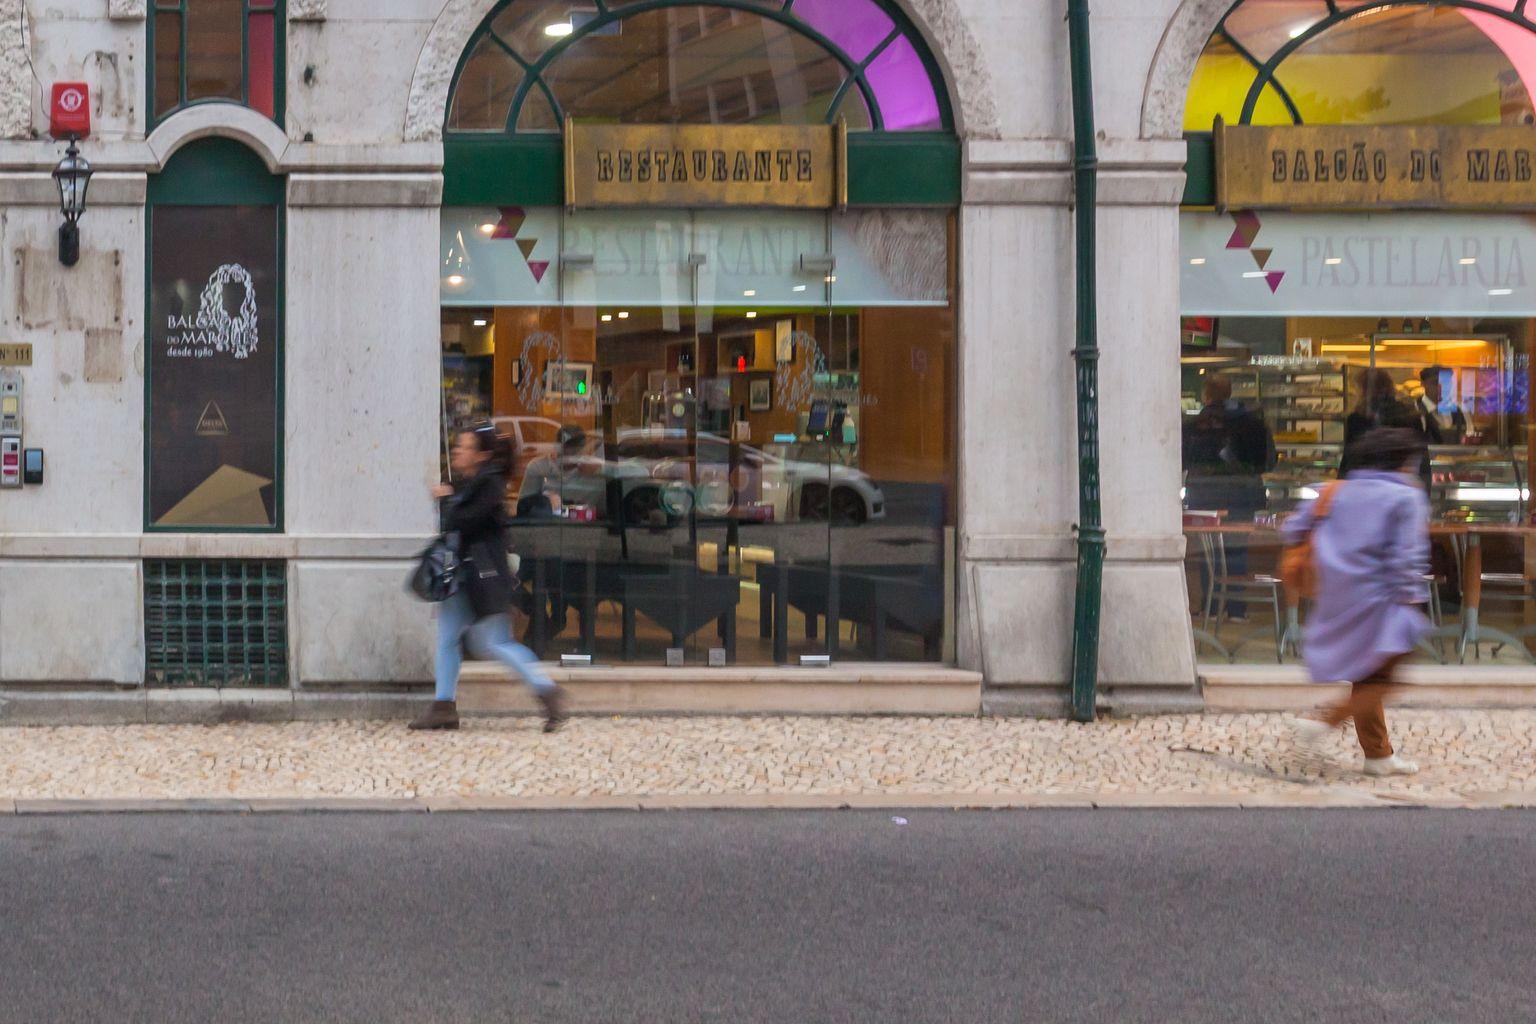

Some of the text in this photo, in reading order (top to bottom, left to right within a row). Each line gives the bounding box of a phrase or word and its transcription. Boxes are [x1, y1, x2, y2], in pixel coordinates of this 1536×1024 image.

[597, 150, 812, 182] RESTAURANTE
[1272, 142, 1387, 183] BALCÃO
[1410, 149, 1442, 183] DO
[1301, 236, 1529, 287] PASTELARIA
[15, 347, 30, 361] 111
[167, 346, 192, 357] desde
